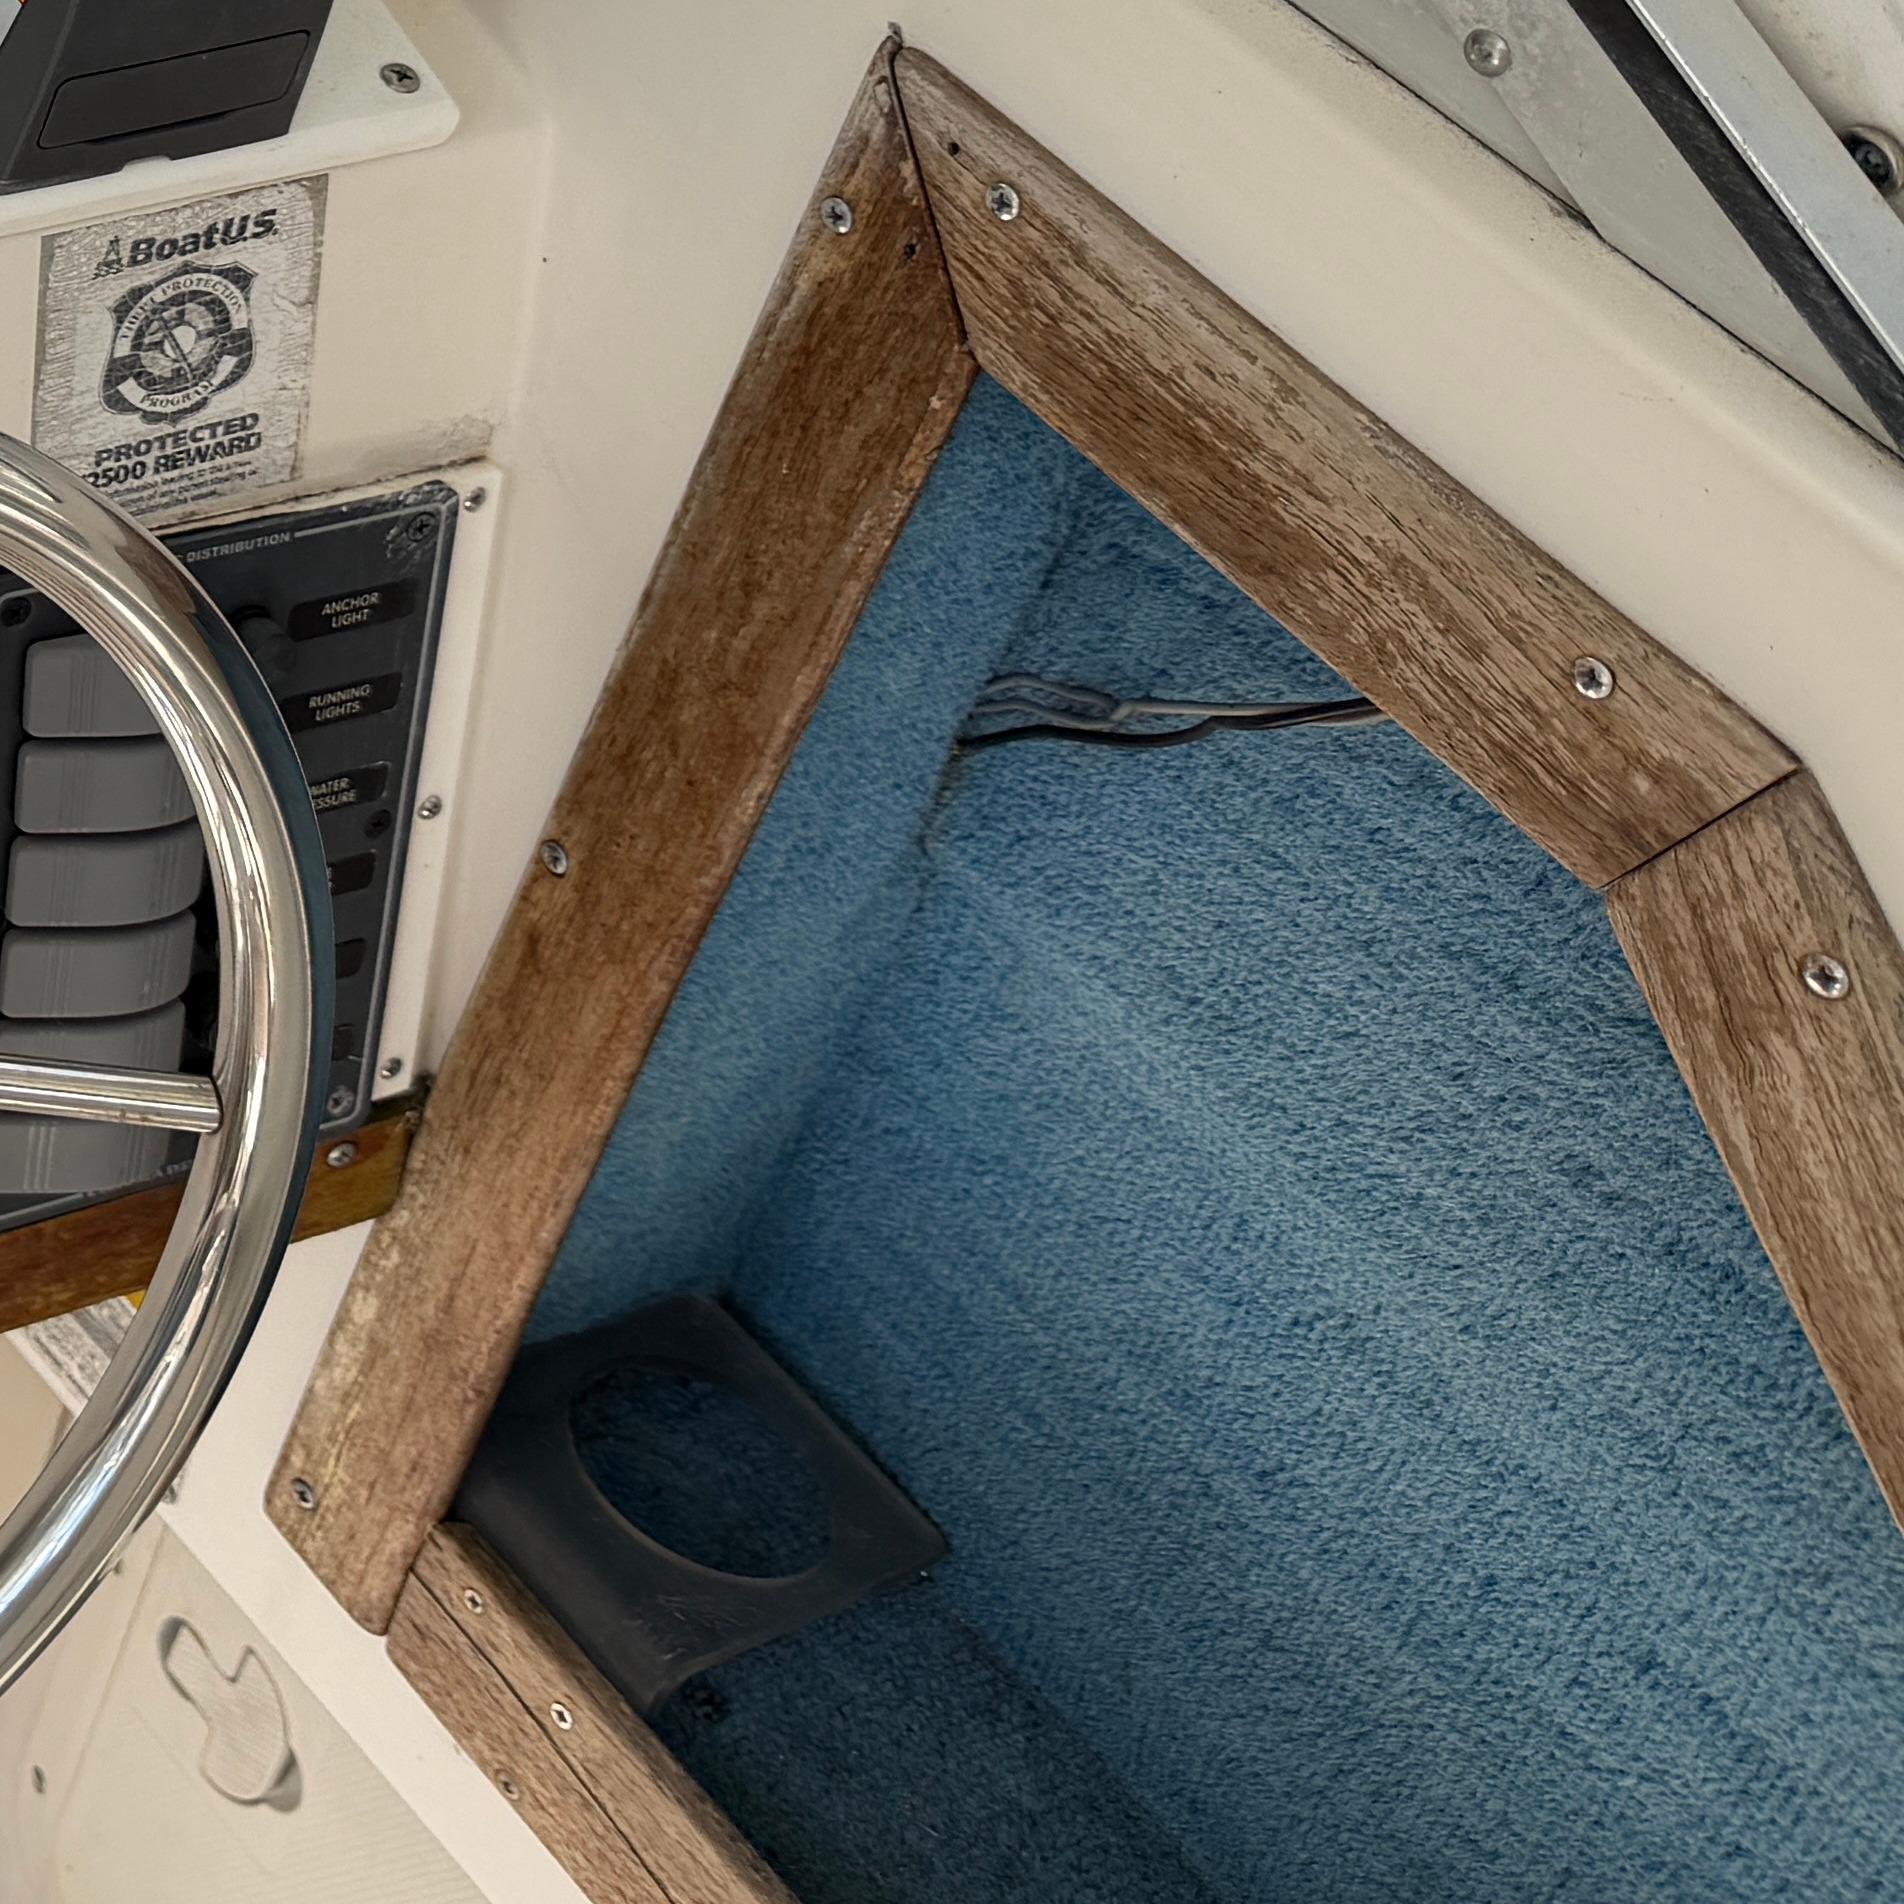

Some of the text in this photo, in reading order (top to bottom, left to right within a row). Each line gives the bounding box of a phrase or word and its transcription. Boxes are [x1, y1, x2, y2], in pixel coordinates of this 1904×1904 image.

[94, 412, 260, 467] PROTECTED
[153, 431, 263, 475] REWARD
[186, 531, 291, 563] DISTRIBUTION
[320, 591, 380, 615] ANCHOR
[330, 608, 372, 628] LIGHT
[308, 683, 371, 709] RUNNING
[315, 700, 361, 722] LIGHTS
[312, 788, 357, 810] ESSURE
